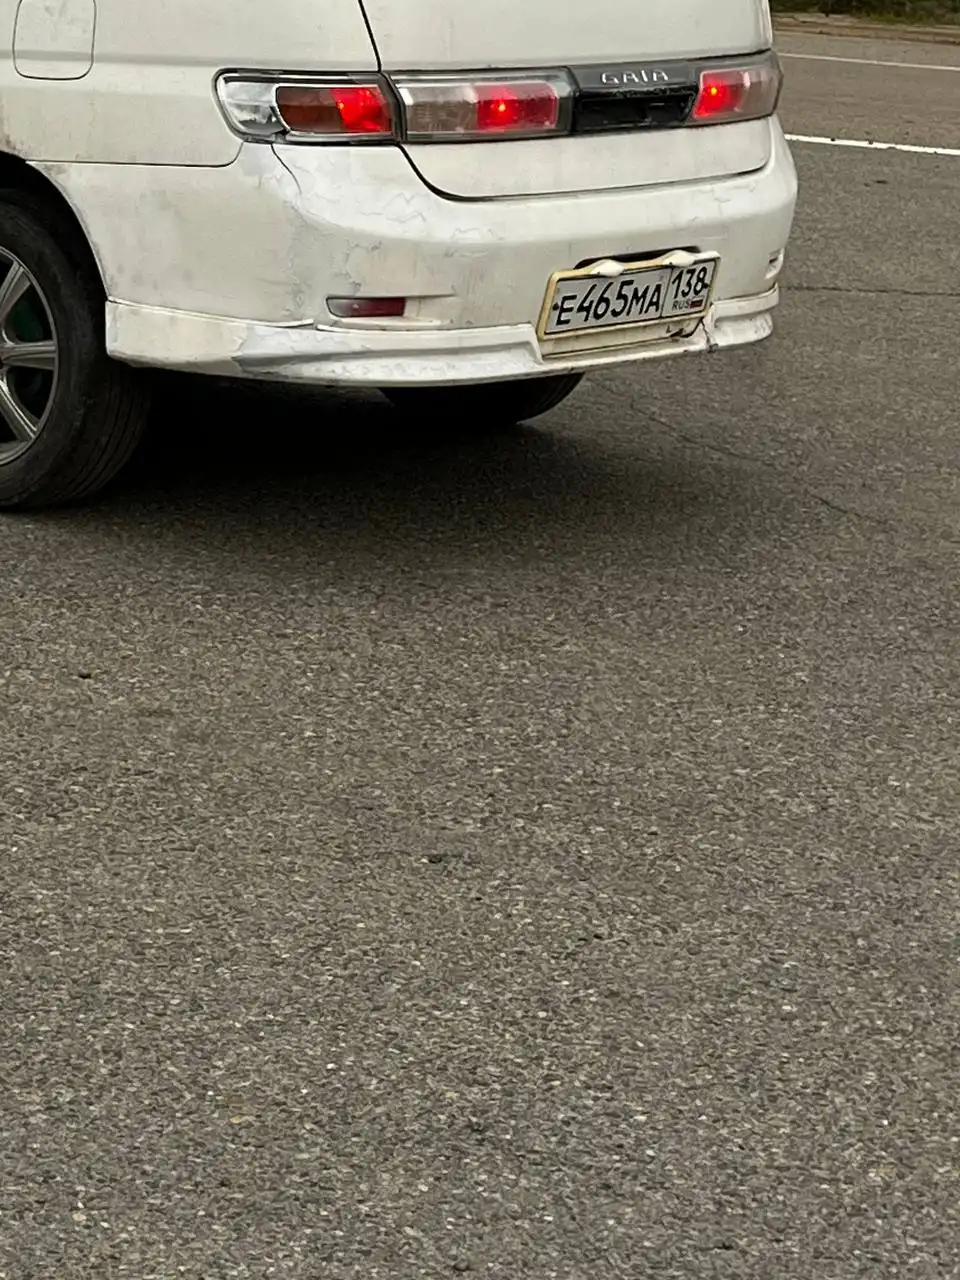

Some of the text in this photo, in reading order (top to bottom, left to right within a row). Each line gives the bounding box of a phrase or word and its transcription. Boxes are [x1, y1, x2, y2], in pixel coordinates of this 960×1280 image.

[601, 69, 669, 85] GAIA
[672, 266, 709, 300] 138
[671, 300, 691, 311] RUS
